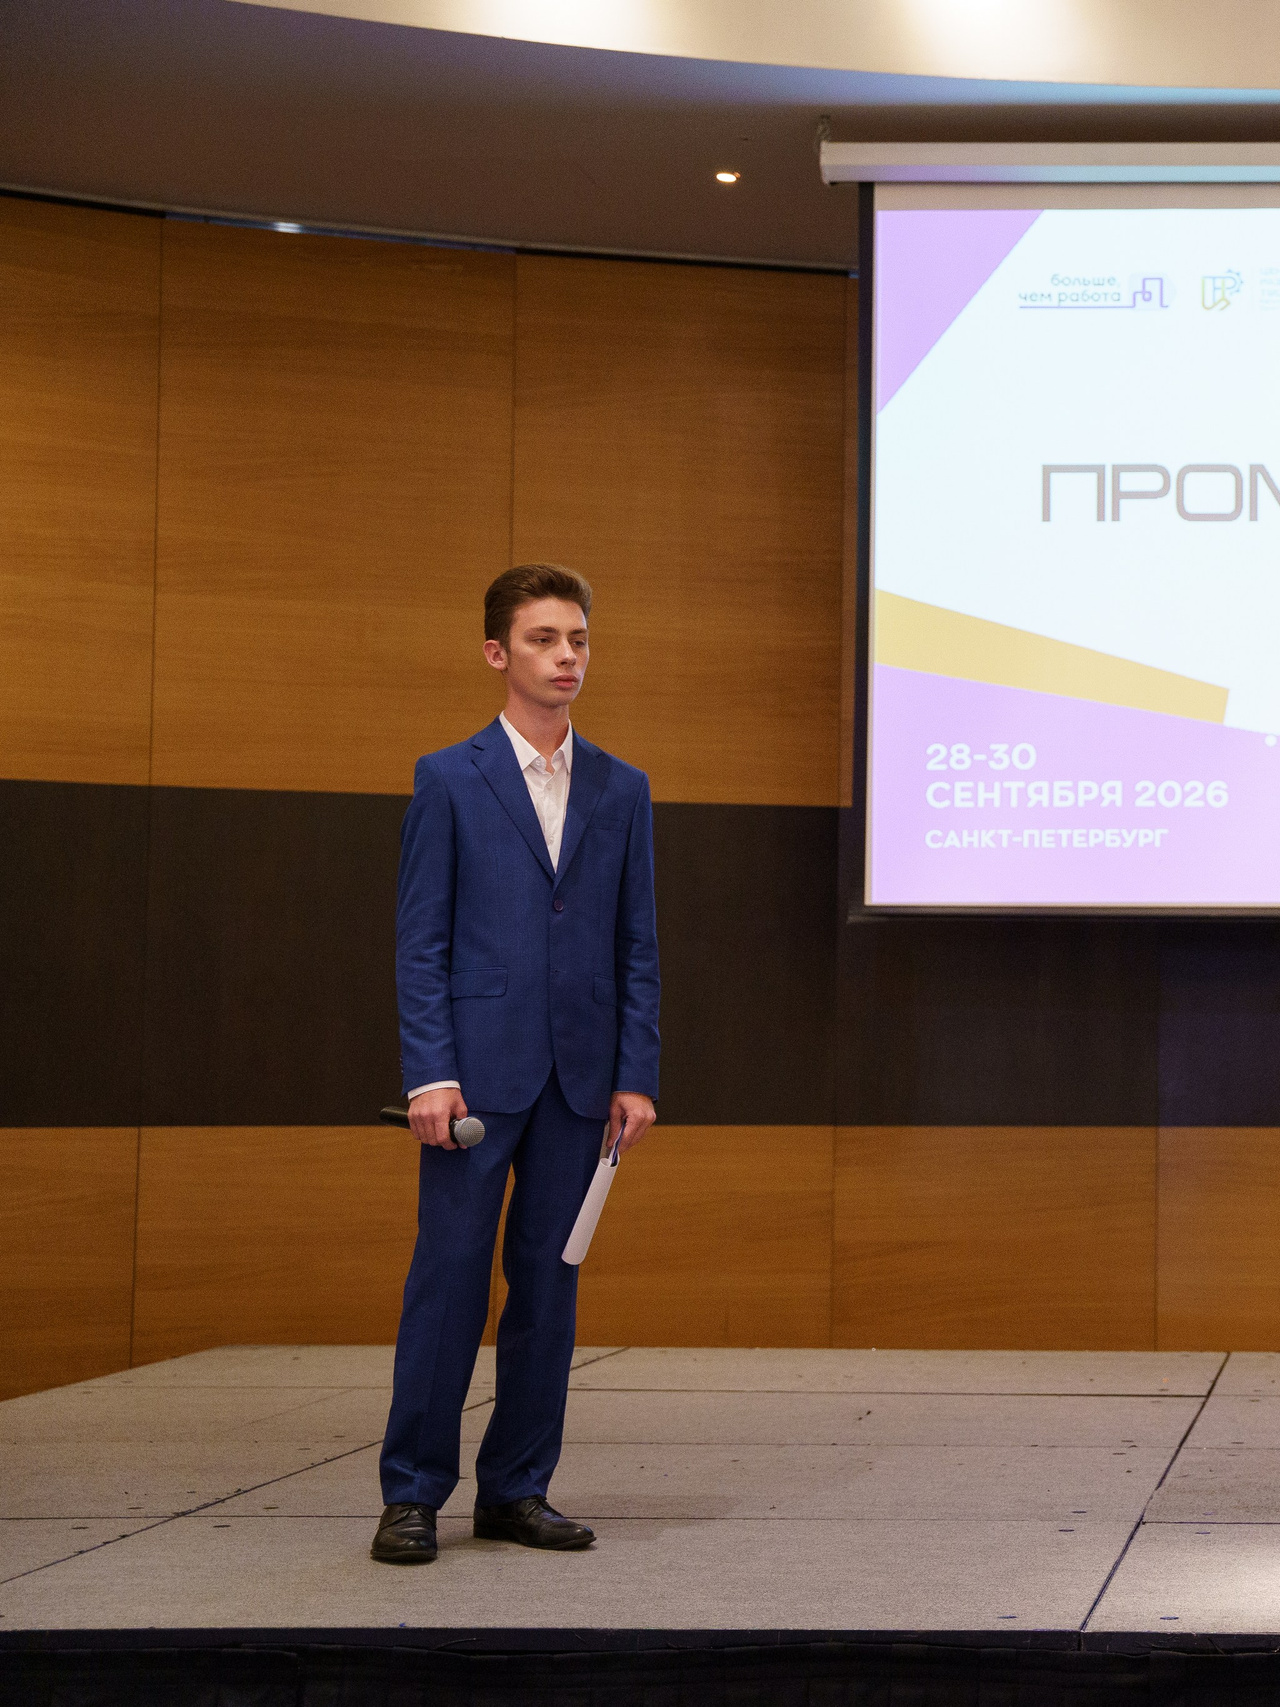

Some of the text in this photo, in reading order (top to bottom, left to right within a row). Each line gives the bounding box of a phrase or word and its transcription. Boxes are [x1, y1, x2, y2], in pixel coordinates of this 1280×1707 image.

[1018, 288, 1121, 306] чем работа
[925, 743, 1036, 771] 28-30
[925, 780, 1230, 808] СЕНТЯБРЯ 2026
[925, 828, 1168, 849] САНКТ-ПЕТЕРБУРГ
